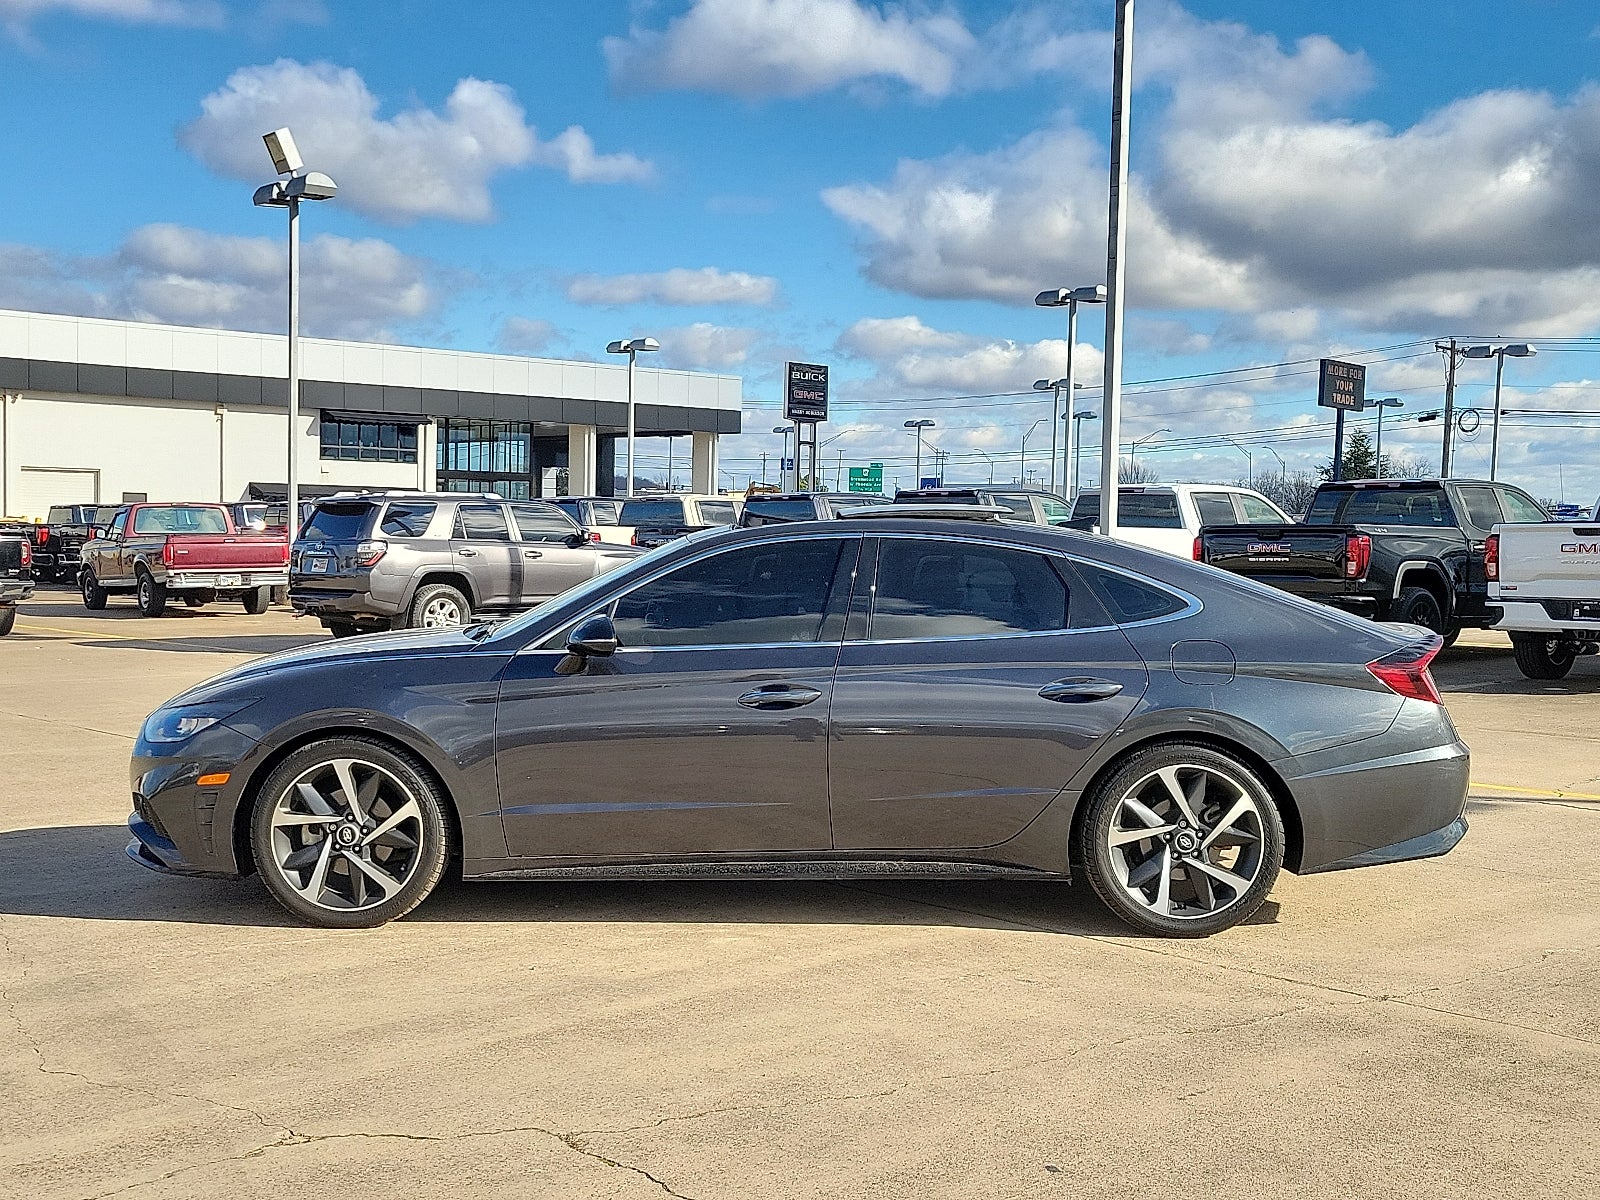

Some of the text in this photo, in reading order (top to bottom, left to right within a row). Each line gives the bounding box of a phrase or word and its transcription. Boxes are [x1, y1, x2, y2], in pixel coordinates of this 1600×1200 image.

[792, 371, 826, 382] BUICK
[1327, 364, 1363, 380] MORE FOR
[1335, 379, 1354, 392] YOUR
[793, 389, 824, 401] GMC
[1332, 392, 1355, 406] TRADE
[1247, 543, 1292, 553] GMC
[1560, 543, 1600, 554] GM
